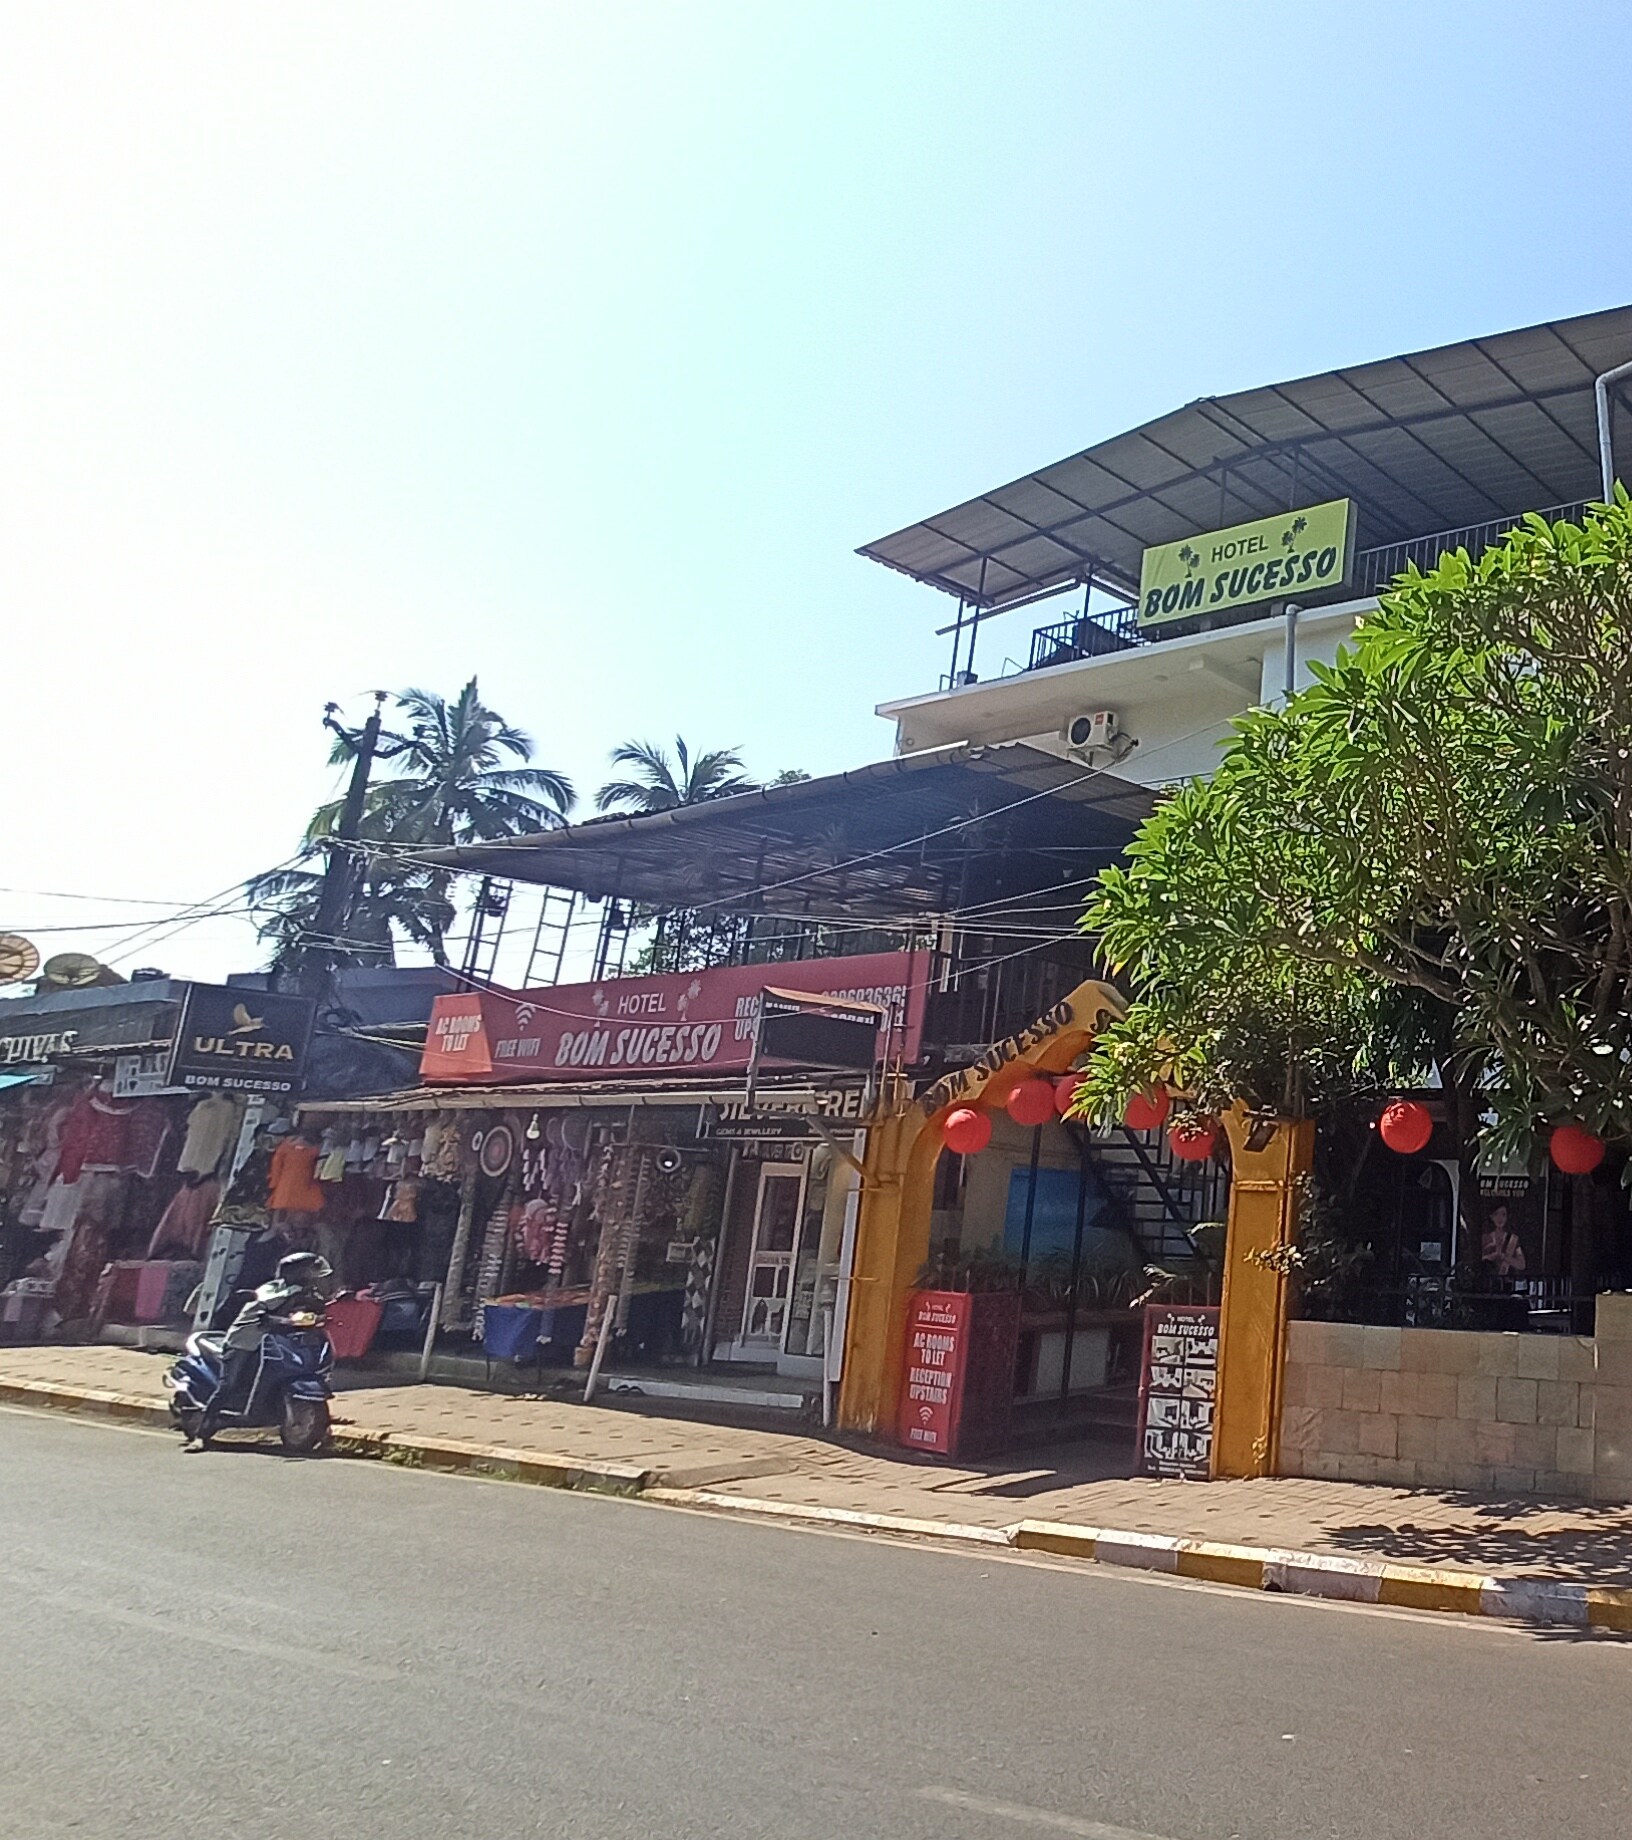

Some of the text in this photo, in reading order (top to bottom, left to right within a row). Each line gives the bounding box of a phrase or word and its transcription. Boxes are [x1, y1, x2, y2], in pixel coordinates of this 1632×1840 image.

[1211, 535, 1269, 563] HOTEL
[1143, 546, 1337, 618] BOM SUCESSO
[617, 993, 666, 1015] HOTEL
[194, 1036, 294, 1061] ULTRA
[555, 1030, 610, 1067] BOM
[610, 1023, 722, 1065] SUCESSO
[973, 1001, 1073, 1081] SUCESSO
[185, 1075, 292, 1092] BOM SUCESSO
[1157, 1323, 1215, 1337] BOM SUCESSO
[914, 1332, 954, 1352] AC ROOMS
[921, 1349, 945, 1366] TO LET
[909, 1367, 953, 1388] RECEPTION
[909, 1385, 948, 1405] UPSTAIRS
